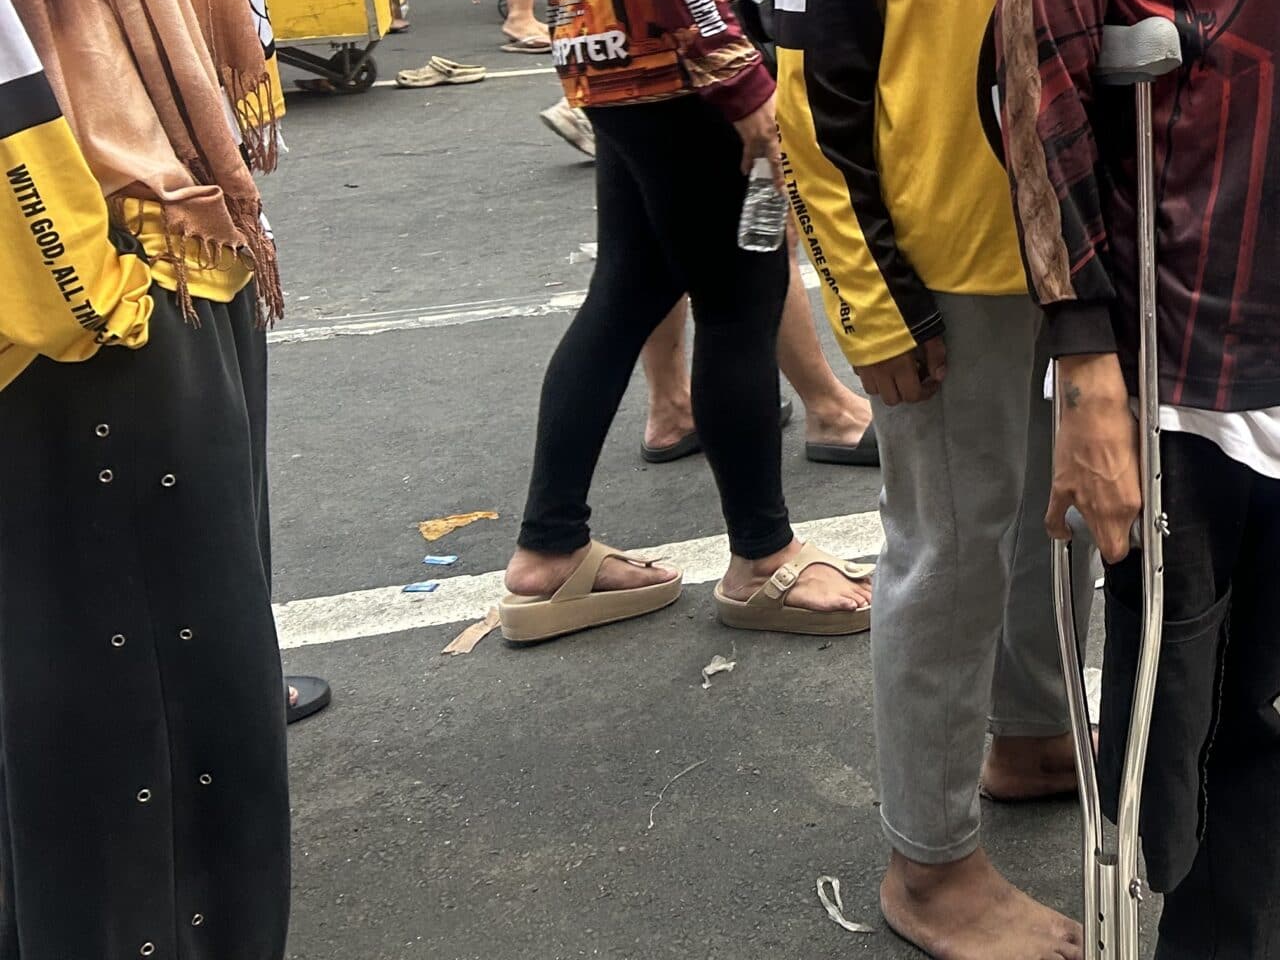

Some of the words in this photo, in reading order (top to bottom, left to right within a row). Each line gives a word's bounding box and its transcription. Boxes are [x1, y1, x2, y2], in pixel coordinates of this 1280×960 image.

[5, 163, 46, 218] WITH
[29, 217, 66, 267] GOD,
[51, 264, 85, 303] ALL
[786, 179, 814, 236] THINGS
[808, 236, 827, 266] ARE
